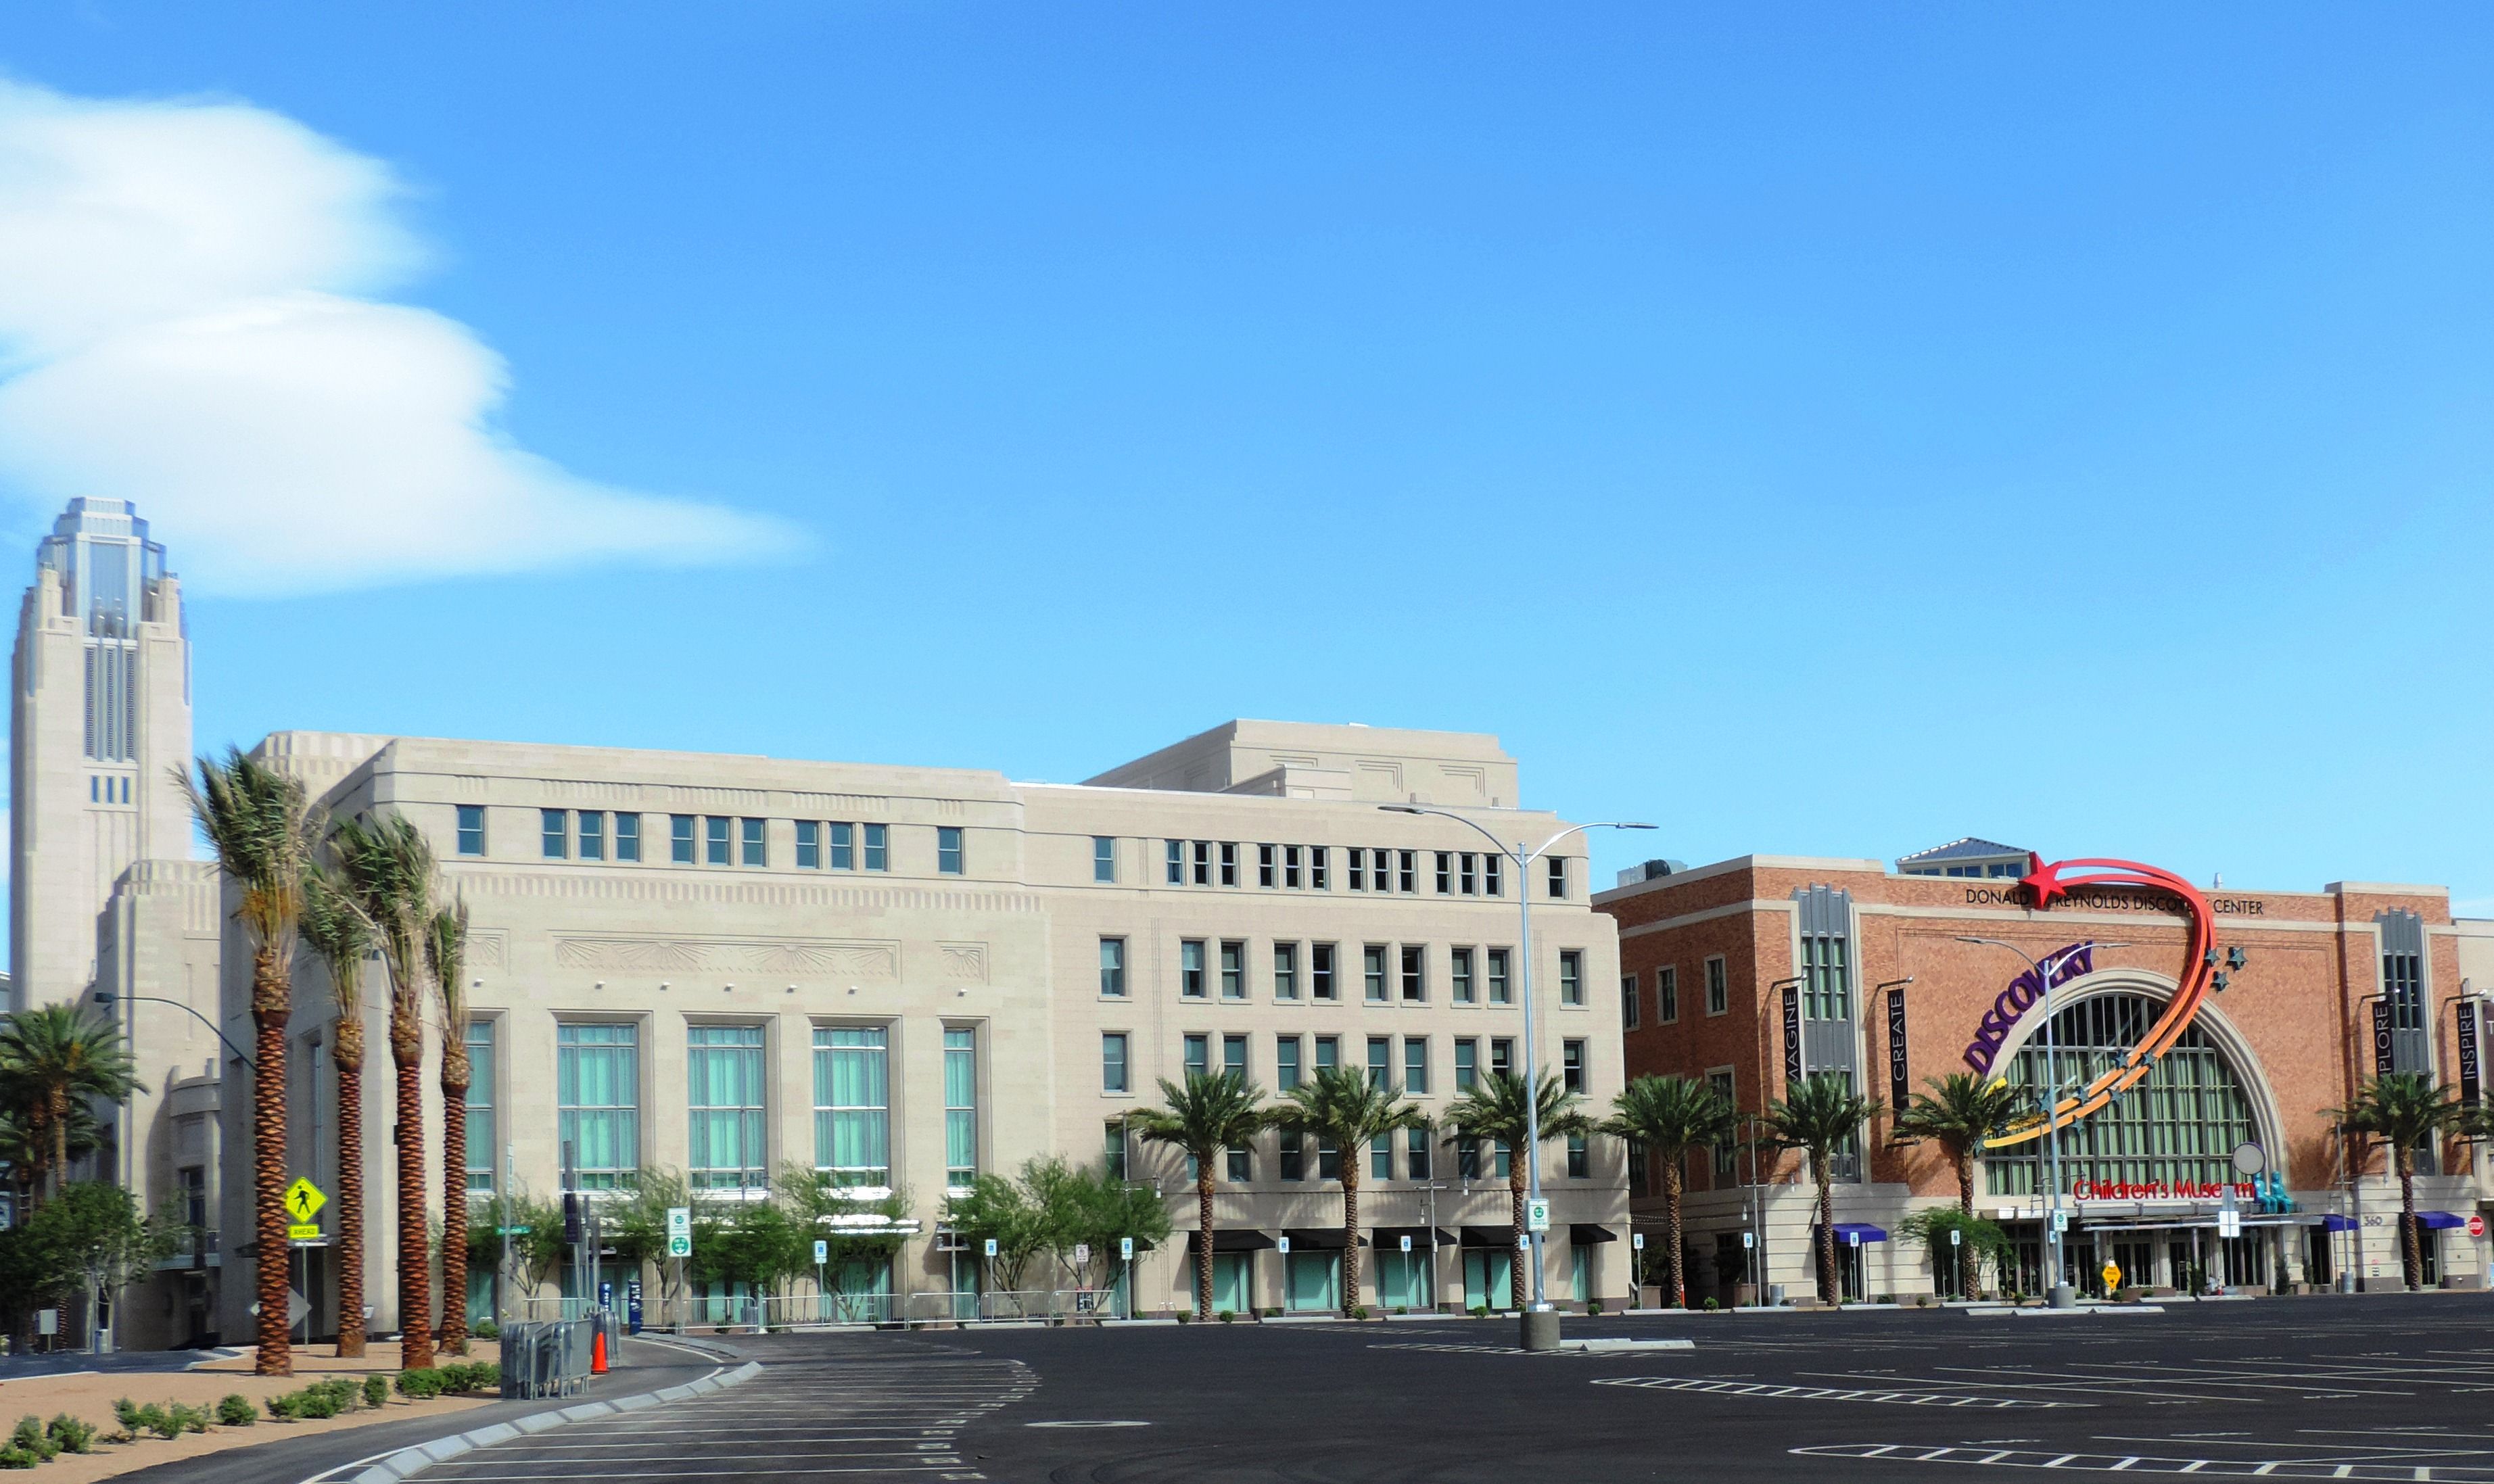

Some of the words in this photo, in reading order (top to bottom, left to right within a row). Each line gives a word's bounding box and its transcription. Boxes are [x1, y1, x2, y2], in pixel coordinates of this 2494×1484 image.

[1966, 889, 2029, 905] DONALD
[2056, 894, 2129, 910] REYNOLDS
[2213, 899, 2263, 915] CENTER
[1785, 993, 1799, 1082] MAGINE
[1891, 996, 1906, 1081] CREATE
[1962, 940, 2094, 1077] DISCOVERY
[2376, 1007, 2392, 1076] PLORE
[2460, 1009, 2476, 1080] INSPIRE
[2073, 1178, 2169, 1200] Children's
[2173, 1178, 2254, 1199] Musem
